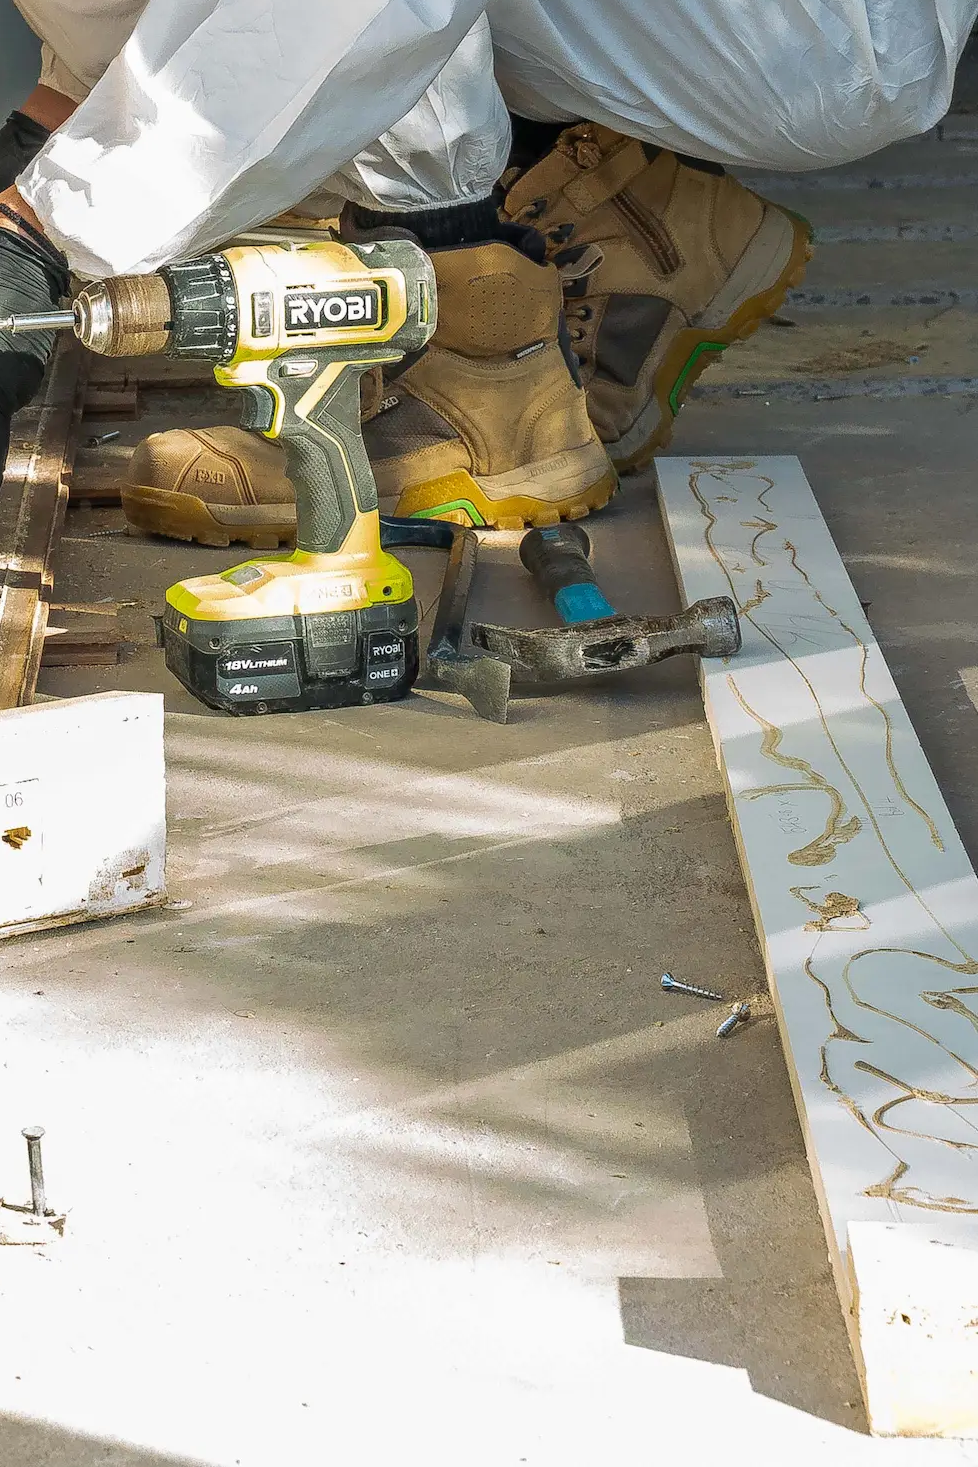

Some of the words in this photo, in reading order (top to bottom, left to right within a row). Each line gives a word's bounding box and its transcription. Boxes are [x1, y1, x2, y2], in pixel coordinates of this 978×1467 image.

[219, 269, 232, 282] 18
[225, 295, 236, 311] 16
[288, 295, 372, 325] RYOBI
[227, 323, 237, 338] 14
[372, 643, 401, 656] RYOBI
[229, 683, 259, 695] 4Ah
[5, 791, 24, 808] 06
